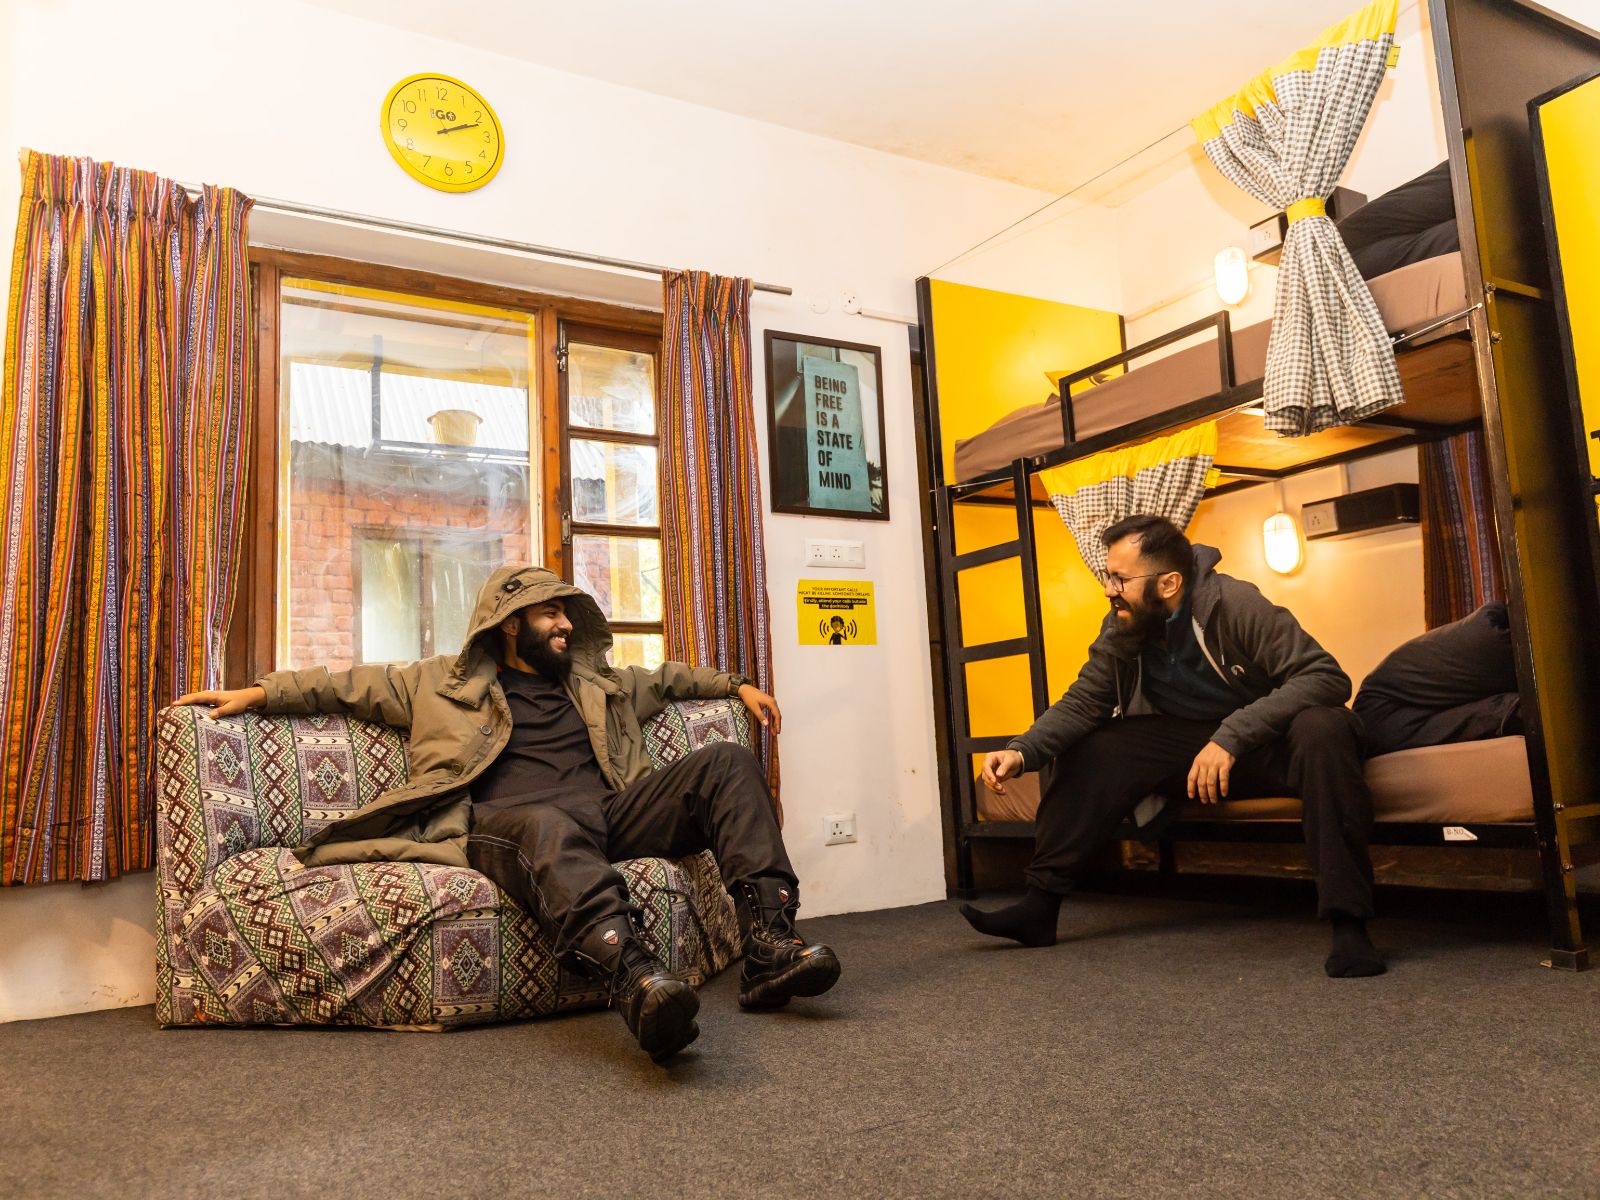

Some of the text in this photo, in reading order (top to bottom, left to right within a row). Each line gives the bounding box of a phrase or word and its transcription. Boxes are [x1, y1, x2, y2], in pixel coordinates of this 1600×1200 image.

[417, 89, 427, 102] 11
[436, 87, 448, 101] 12
[402, 99, 417, 114] 10
[460, 95, 466, 108] 1
[474, 110, 483, 124] 2
[397, 118, 408, 131] 9
[406, 138, 414, 150] 8
[483, 130, 491, 144] 3
[423, 155, 431, 167] 7
[478, 149, 486, 159] 4
[444, 162, 453, 176] 6
[464, 160, 473, 174] 5
[814, 374, 847, 394] BEING
[815, 393, 843, 411] FREE
[816, 410, 840, 430] IS A
[817, 430, 853, 450] STATE
[818, 449, 833, 467] OF
[819, 470, 852, 490] MIND
